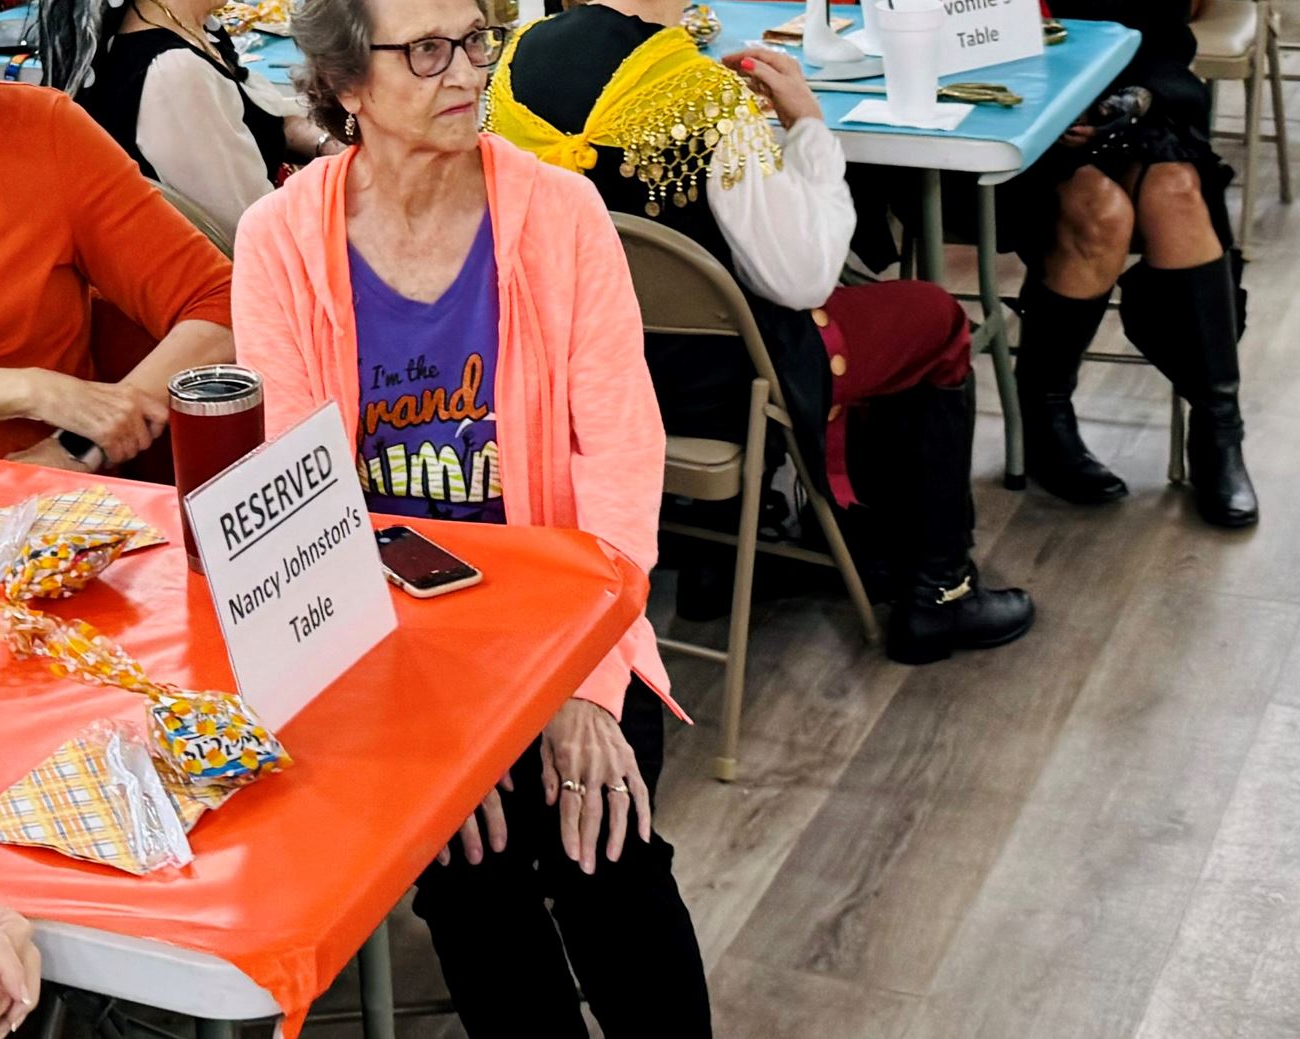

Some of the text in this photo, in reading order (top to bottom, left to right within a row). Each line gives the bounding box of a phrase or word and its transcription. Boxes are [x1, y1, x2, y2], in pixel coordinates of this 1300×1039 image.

[956, 26, 1000, 49] Table
[357, 351, 488, 438] rand
[371, 354, 440, 390] I'm the
[219, 444, 334, 552] RESERVED
[227, 506, 362, 626] Nancy Johnston's
[288, 595, 335, 644] Table
